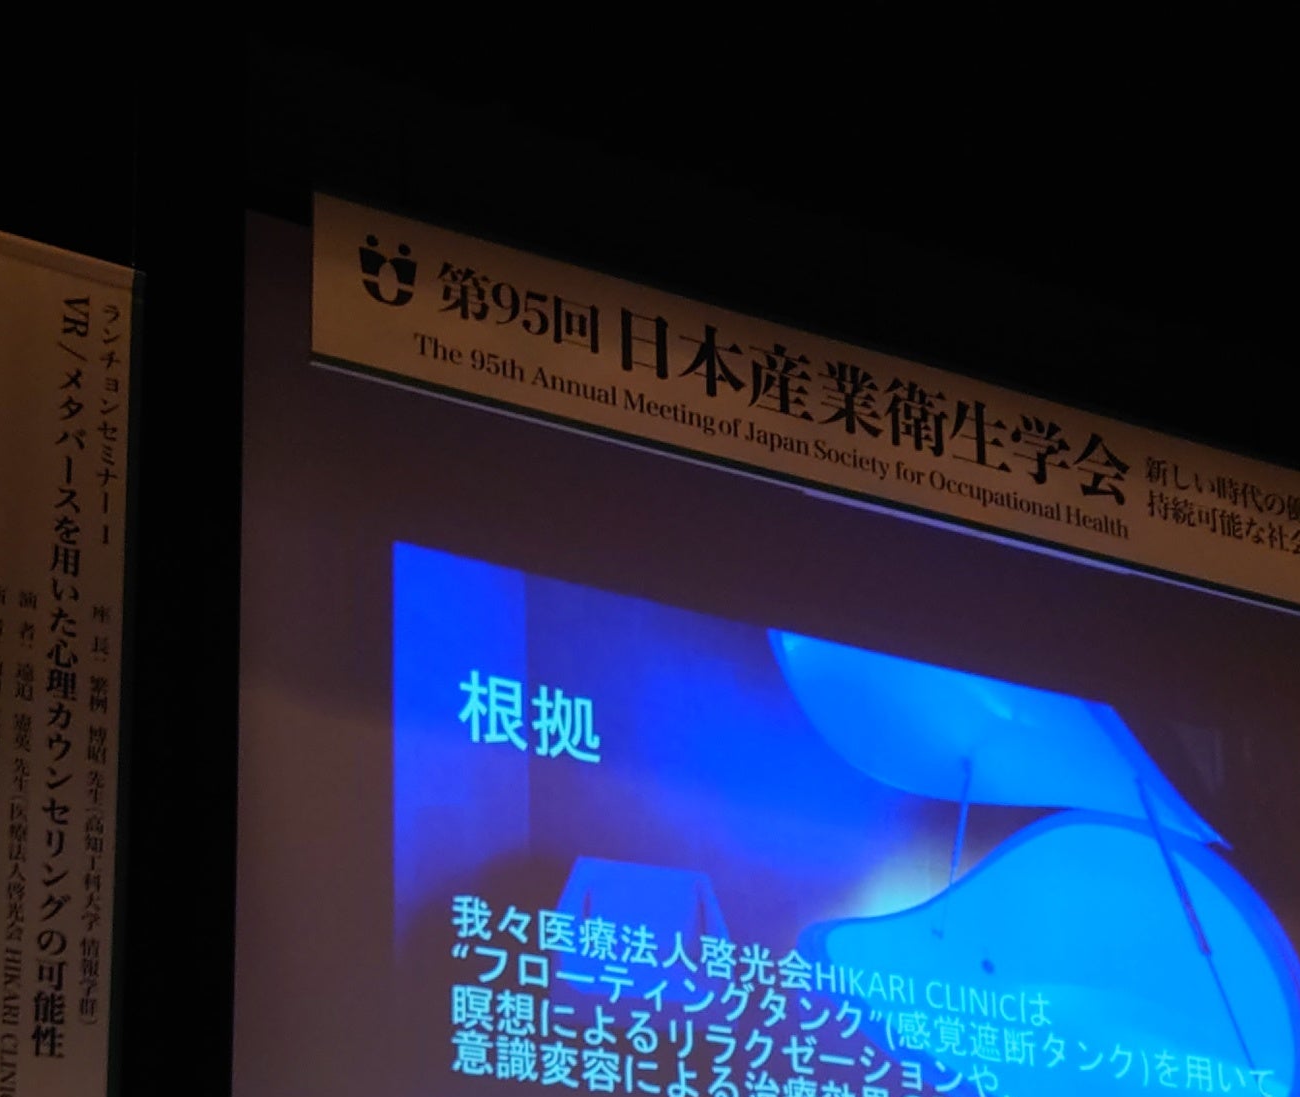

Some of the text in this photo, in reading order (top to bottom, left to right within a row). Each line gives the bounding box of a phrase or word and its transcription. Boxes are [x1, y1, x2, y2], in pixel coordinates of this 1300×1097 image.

[413, 333, 1130, 541] The 95th Annual Meeting of Japan Society for Occupational Health
[437, 261, 1131, 506] 第95回 日本産業衛生学会
[459, 670, 601, 763] 根拠
